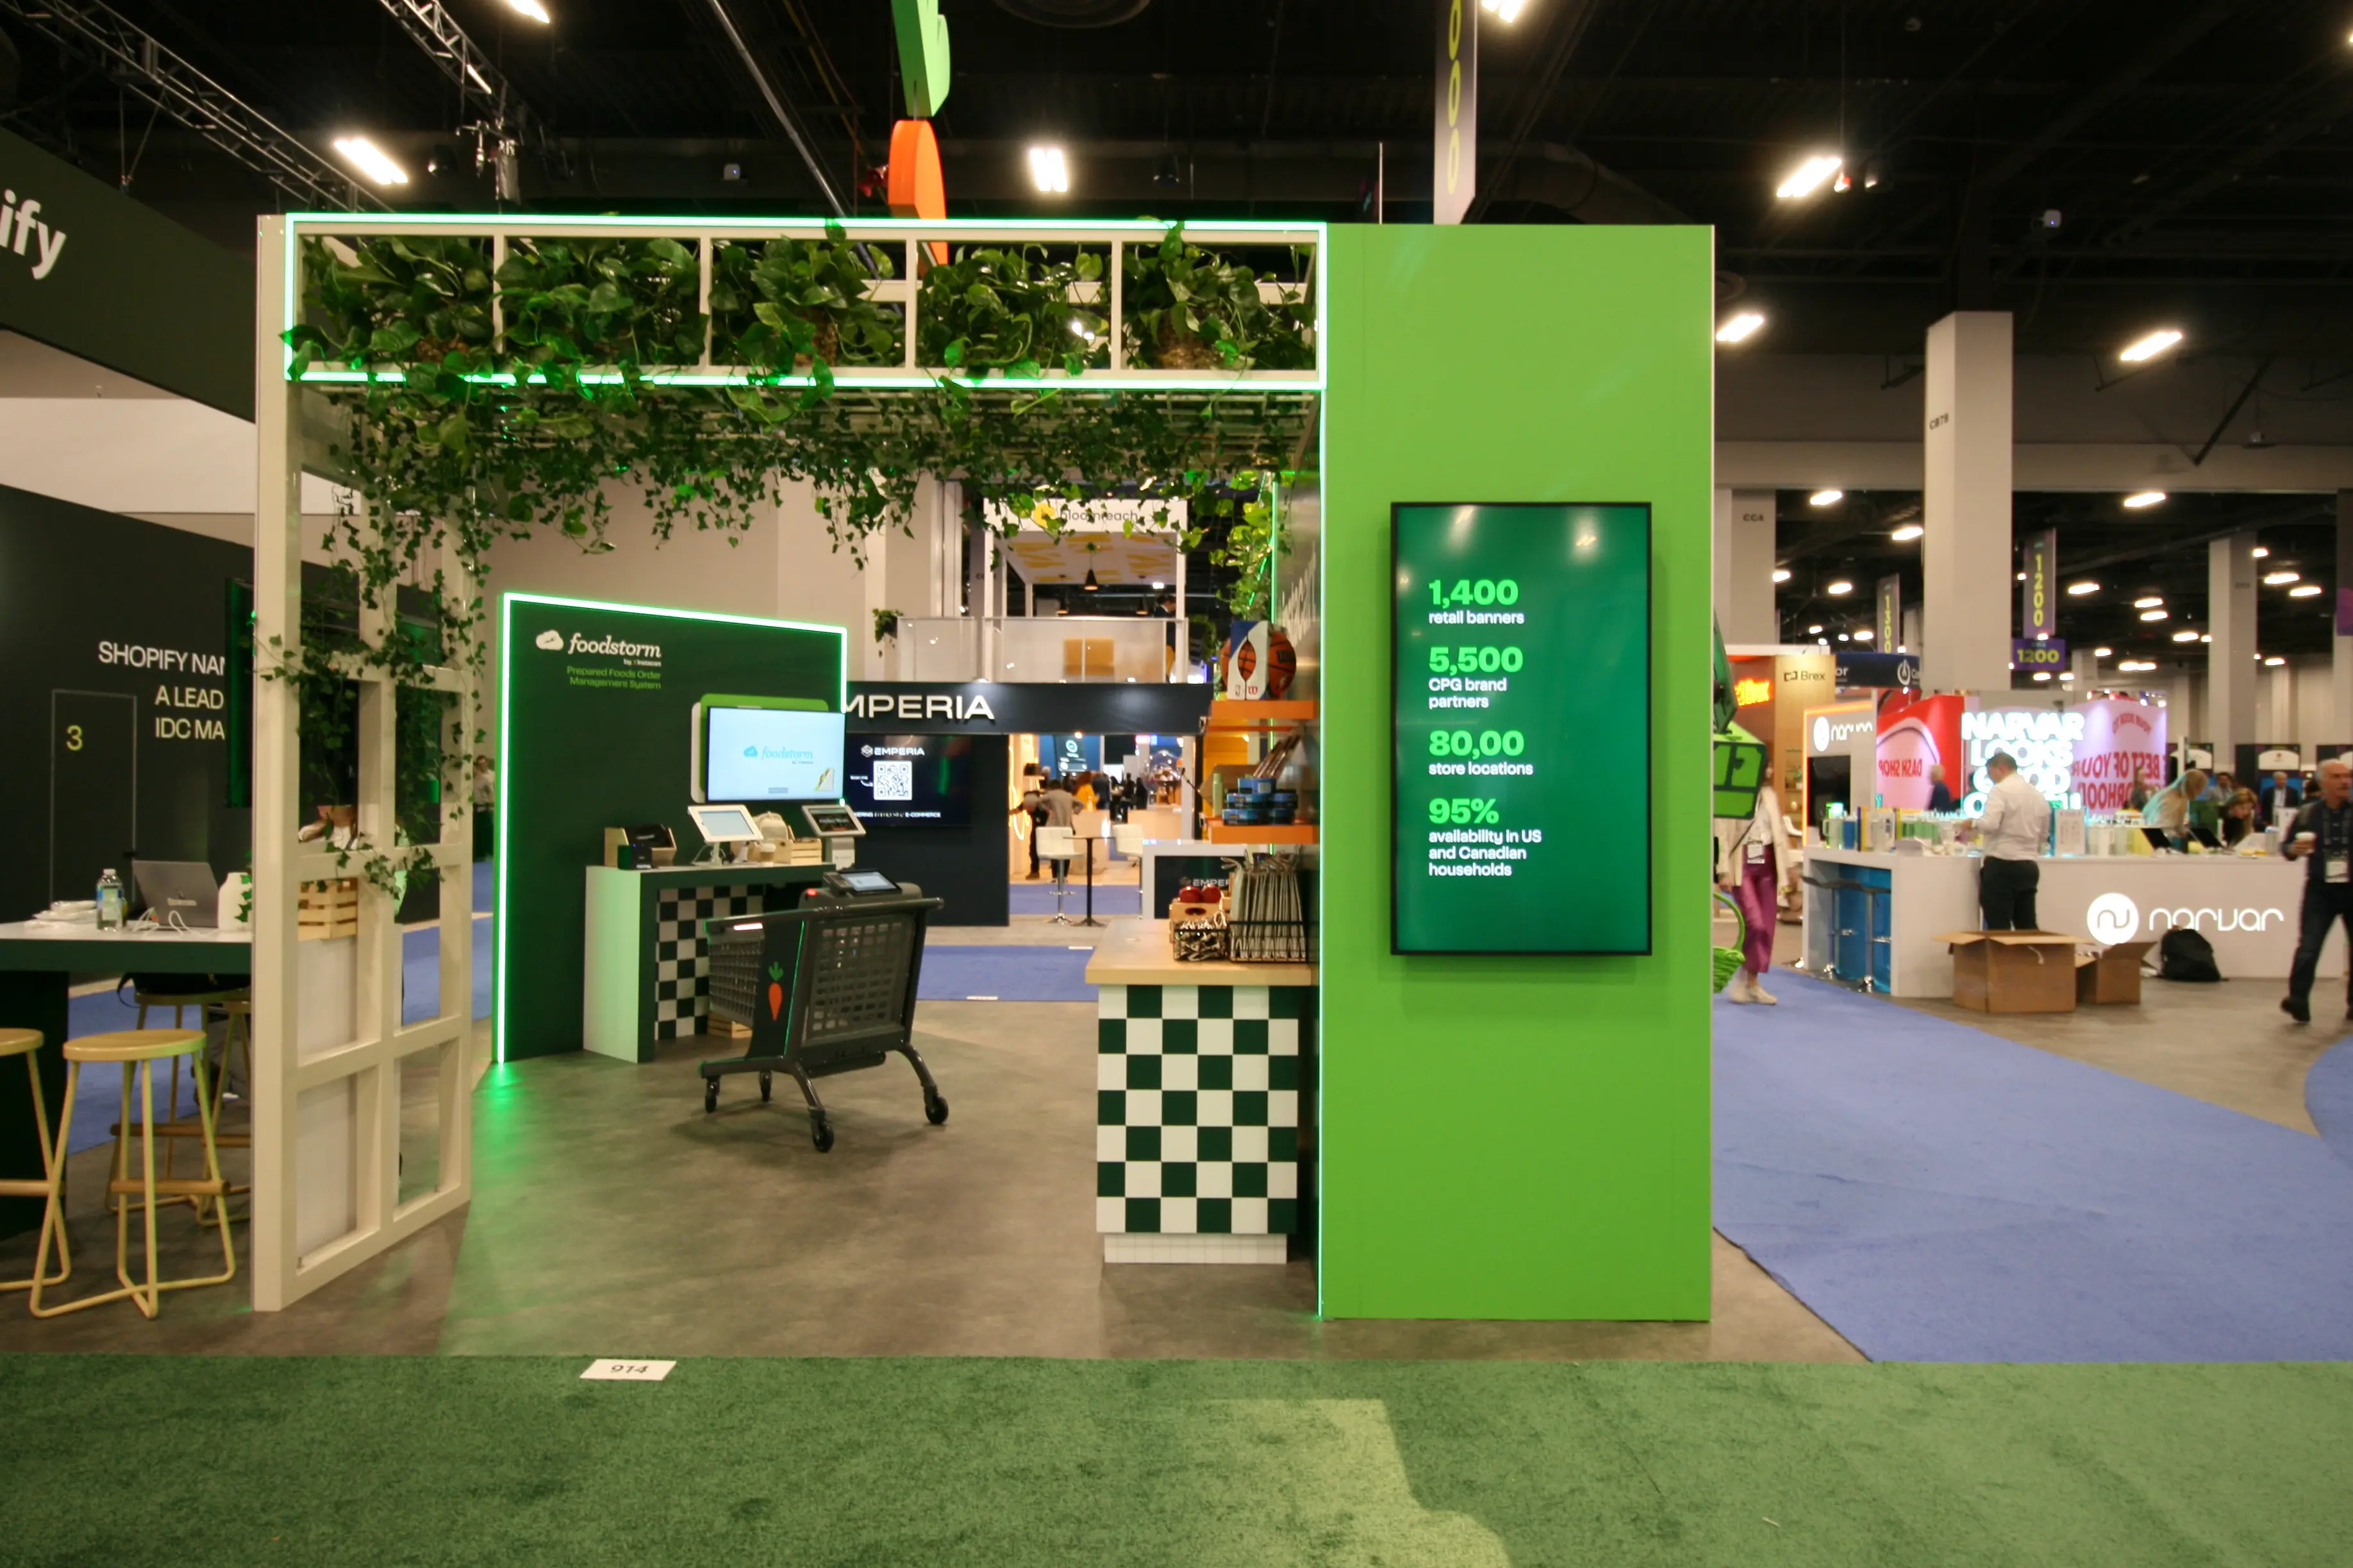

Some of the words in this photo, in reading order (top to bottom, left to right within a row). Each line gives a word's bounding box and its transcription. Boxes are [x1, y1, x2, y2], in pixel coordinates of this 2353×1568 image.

[1429, 579, 1518, 609] 1,400
[2033, 554, 2043, 627] 1200
[1429, 610, 1464, 625] retail
[1467, 610, 1525, 625] banners
[567, 632, 661, 658] foodstorm
[99, 641, 188, 672] SHOPIFY
[1429, 647, 1524, 676] 5,500
[2017, 649, 2059, 663] 1200
[567, 666, 608, 677] Prepared
[608, 668, 636, 679] Foods
[637, 670, 661, 680] Order
[1800, 670, 1825, 681] Brex
[570, 677, 628, 689] Management
[629, 680, 661, 690] System
[1428, 677, 1462, 692] CPG
[1465, 677, 1508, 692] brand
[154, 684, 170, 706] A
[174, 686, 224, 709] LEAD
[1429, 695, 1490, 710] partners
[155, 717, 190, 739] IDC
[1961, 712, 2085, 741] NARVAR
[67, 725, 83, 750] 3
[1429, 730, 1525, 760] 80,00
[761, 746, 813, 760] foodstorm
[874, 747, 926, 756] EMPERIA
[1970, 738, 2073, 768] LOOKS
[1428, 761, 1465, 775] store
[1468, 761, 1534, 775] locations
[1973, 766, 2071, 795] GOD
[1429, 798, 1500, 825] 95%
[1429, 829, 1503, 845] availability
[1506, 829, 1519, 843] in
[1522, 829, 1542, 843] US
[1429, 845, 1456, 860] and
[1458, 845, 1527, 860] Canadian
[1429, 862, 1513, 877] households
[2149, 907, 2284, 932] narvar
[610, 1364, 649, 1374] 914
